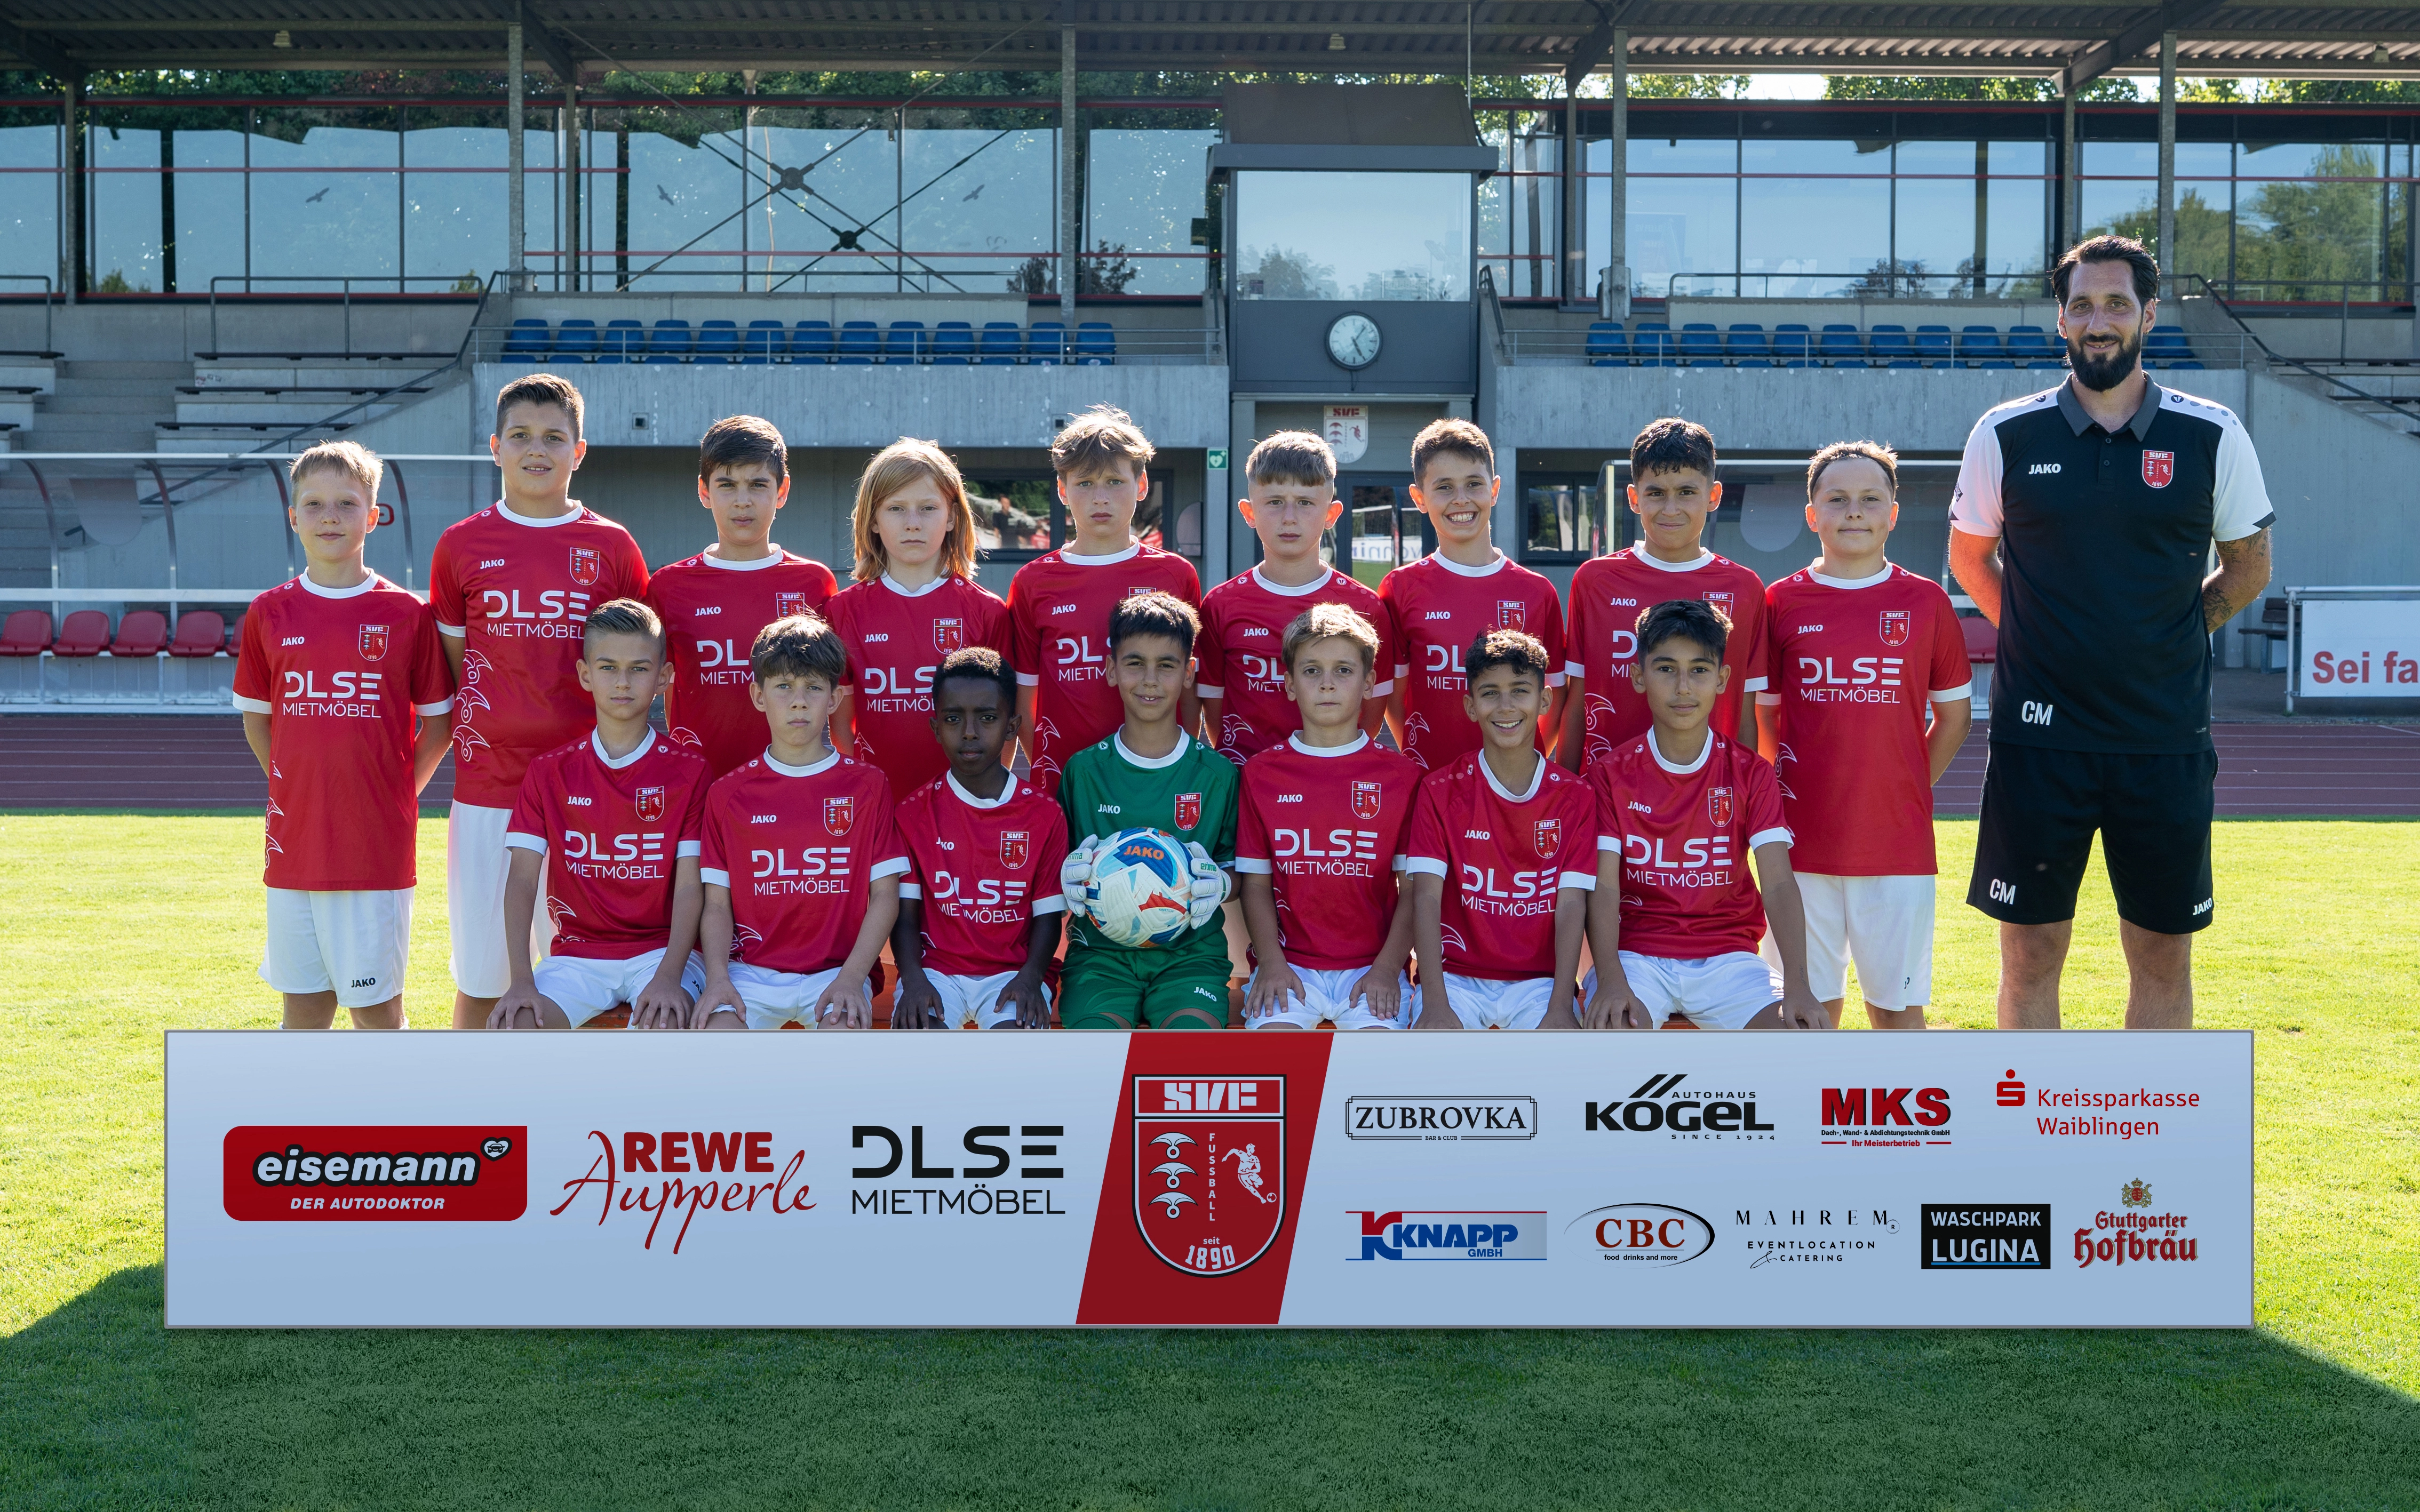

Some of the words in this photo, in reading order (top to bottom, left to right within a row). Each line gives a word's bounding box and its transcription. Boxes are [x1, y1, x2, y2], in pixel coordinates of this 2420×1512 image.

[2029, 463, 2061, 474] JAKO
[480, 559, 504, 569] JAKO
[483, 590, 590, 622] DLSE
[695, 606, 721, 616] JAKO
[1052, 604, 1076, 614] JAKO
[1611, 598, 1636, 606] JAKO
[487, 621, 584, 639] MIETMÖBEL
[865, 634, 888, 642] JAKO
[1244, 628, 1269, 636] JAKO
[1798, 625, 1823, 634] JAKO
[282, 637, 304, 646] JAKO
[1056, 636, 1111, 664] DL
[697, 639, 749, 667] DL
[1427, 645, 1466, 673] DL
[1058, 667, 1106, 681] MIETM
[1243, 654, 1285, 680] DL
[1800, 657, 1903, 685] DLSE
[2313, 651, 2369, 683] Sei
[2384, 651, 2418, 683] fa
[284, 671, 381, 700] DLSE
[700, 671, 754, 685] MIETM
[864, 666, 936, 694] DLS
[867, 695, 935, 712] MIETMÖ
[1801, 687, 1900, 703] MIETMÖBEL
[283, 701, 381, 718] MIETMÖBEL
[2022, 701, 2053, 725] CM
[568, 796, 592, 806] JAKO
[1277, 794, 1302, 802] JAKO
[1628, 801, 1651, 813] JAKO
[1098, 804, 1120, 814] JAKO
[751, 815, 776, 823] JAKO
[936, 837, 954, 850] JKO
[1275, 829, 1378, 860] DLSE
[1465, 830, 1490, 840] JAKO
[564, 830, 664, 861] DLSE
[1124, 845, 1165, 860] JAKO
[1626, 834, 1732, 868] DLSE
[566, 860, 664, 879] MIETMÖBEL
[752, 847, 850, 878] DLSE
[1200, 862, 1217, 872] erima
[1277, 859, 1374, 878] MIETMÖBEL
[754, 878, 849, 896] MIETMÖBEL
[1462, 862, 1557, 899] DLSE
[1627, 869, 1733, 888] MIETMÖBEL
[934, 871, 1026, 906] DLSE
[1990, 879, 2016, 905] CM
[1461, 894, 1555, 916] MIETMÖBEL
[2193, 898, 2212, 915] JAKO
[352, 978, 376, 988] JAKO
[1194, 987, 1216, 1001] JAKO
[1164, 1083, 1256, 1110] SVF
[2039, 1088, 2199, 1111] Kreissparkasse
[1822, 1087, 1951, 1126] MKS
[1356, 1107, 1527, 1129] ZUBROVKA
[2037, 1117, 2159, 1140] Waiblingen
[624, 1132, 774, 1172] REWE
[853, 1126, 1064, 1178] DLSE
[257, 1148, 476, 1182] eisemann
[550, 1130, 817, 1254] Aupperle
[853, 1183, 1065, 1214] MIETMÖBEL
[290, 1198, 324, 1209] DER
[330, 1198, 445, 1209] AUTODOKTOR
[1737, 1210, 1886, 1225] MAHREM
[1931, 1212, 2041, 1226] WASCHPARK
[2095, 1210, 2188, 1233] Stuttgarter
[1203, 1236, 1220, 1244] seit
[1393, 1225, 1518, 1247] KNAPP
[1595, 1218, 1685, 1249] CBC
[1185, 1245, 1236, 1269] 1890
[1468, 1249, 1502, 1257] GMBH
[1933, 1239, 2039, 1261] LUGINA
[2074, 1228, 2199, 1268] Hofbräu
